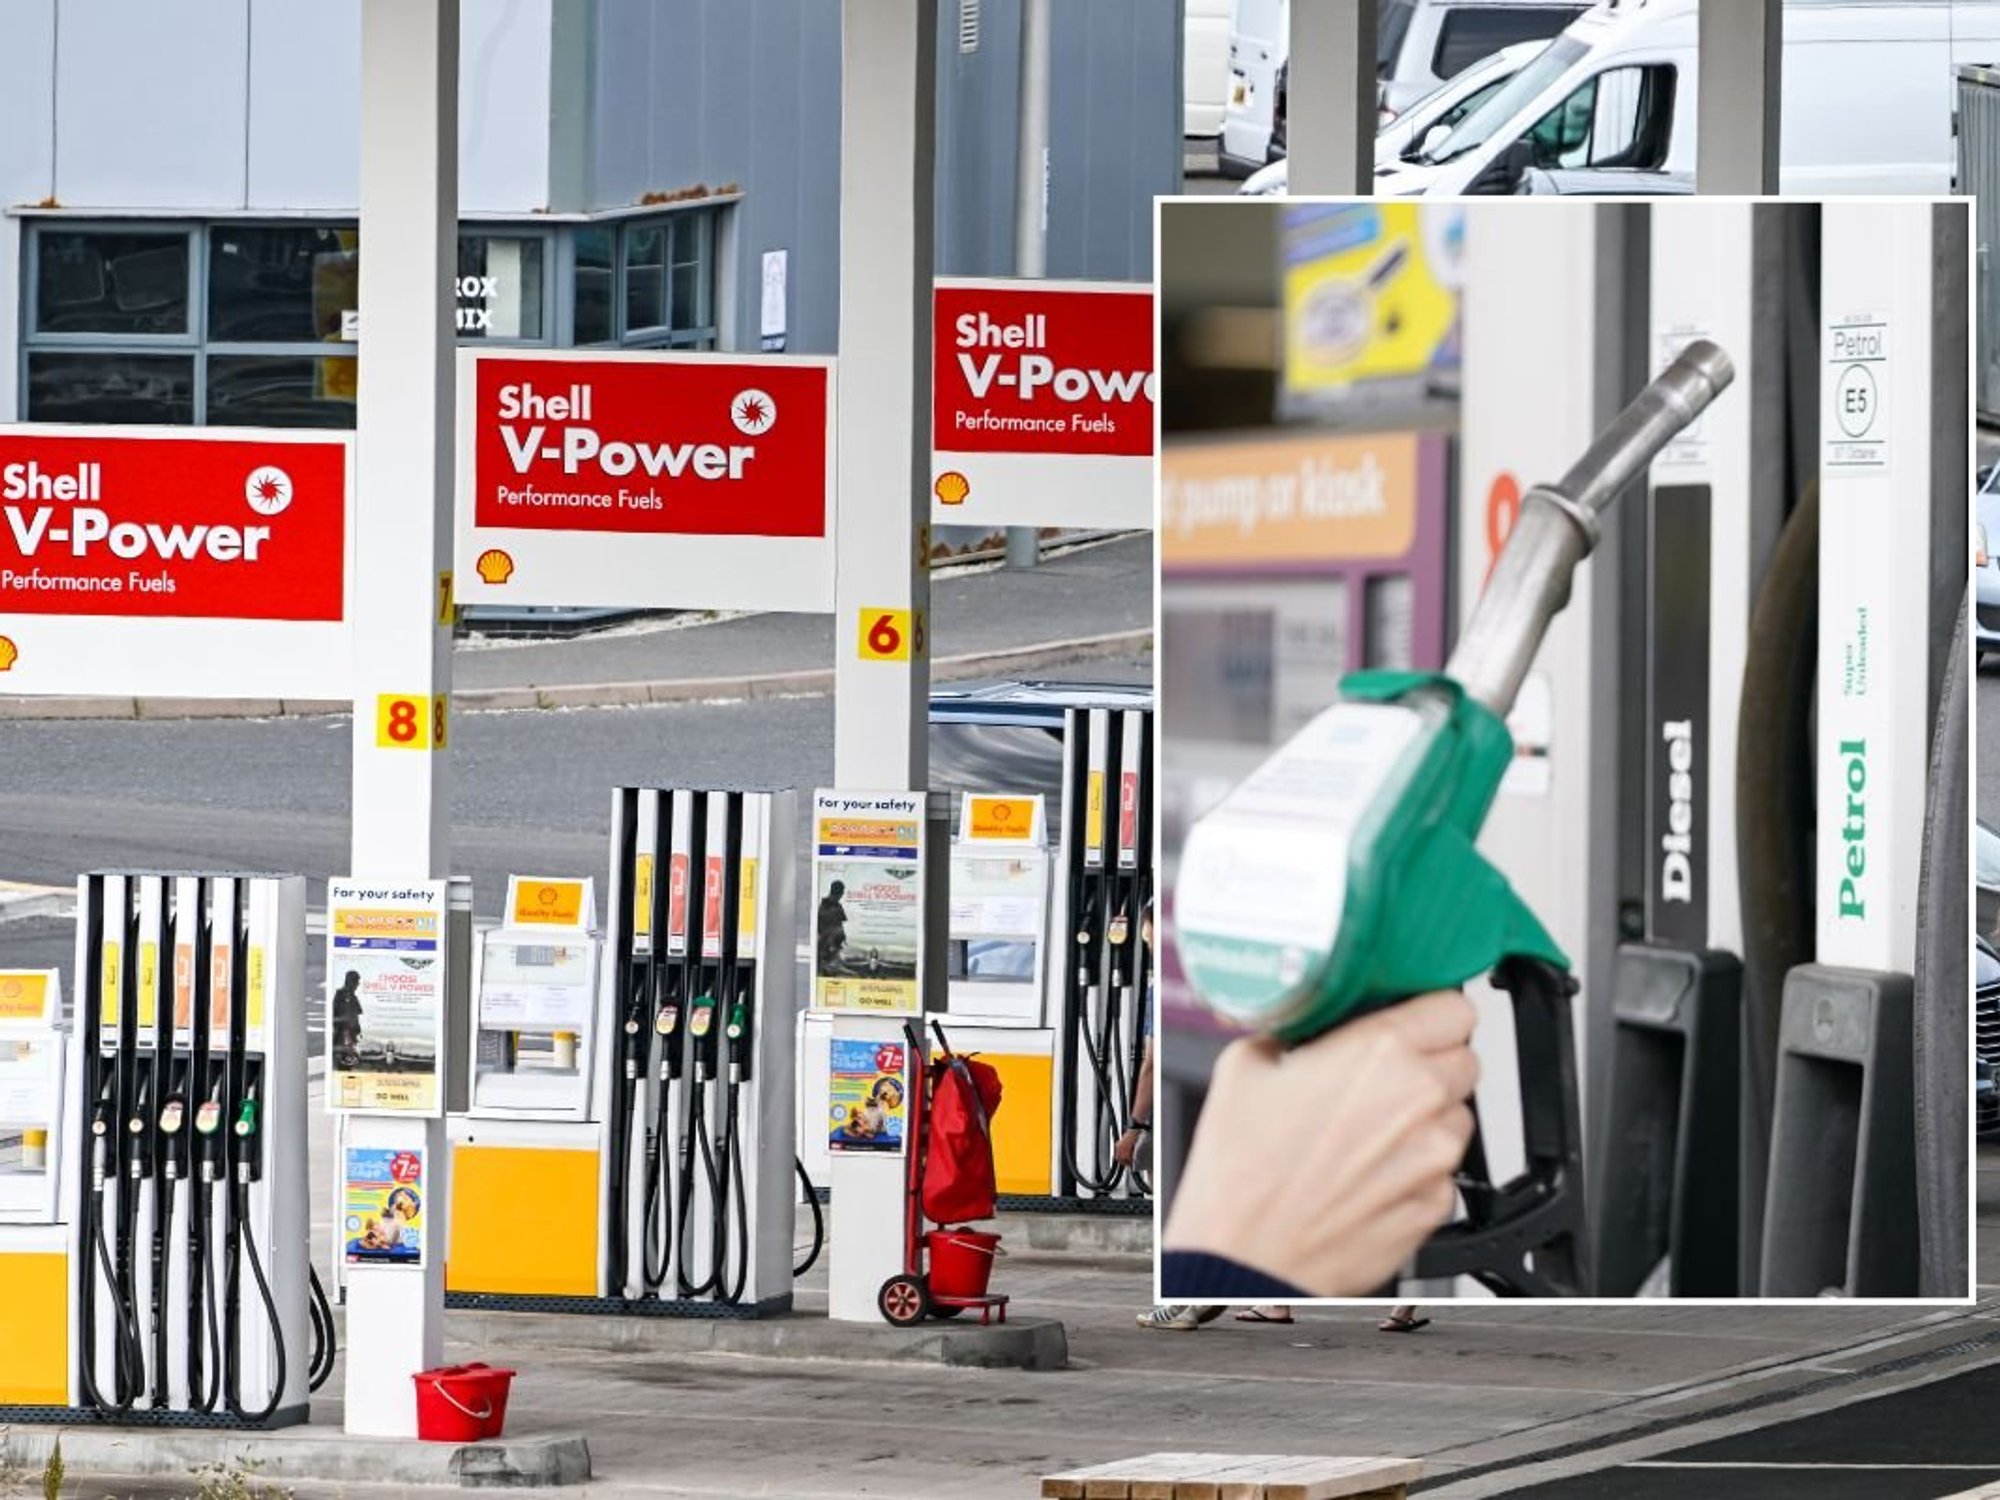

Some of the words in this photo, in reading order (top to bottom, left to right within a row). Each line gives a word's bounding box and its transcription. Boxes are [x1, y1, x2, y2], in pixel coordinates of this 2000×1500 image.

[956, 311, 1046, 348] Shell
[1834, 331, 1882, 356] Petrol
[498, 383, 592, 421] Shell
[1845, 389, 1867, 413] E5
[956, 409, 1066, 432] Performance
[1072, 412, 1116, 433] Fuels
[499, 425, 755, 480] V-Power
[3, 461, 100, 501] Shell
[497, 484, 613, 507] Performance
[618, 487, 664, 510] Fuels
[4, 506, 271, 560] V-Power
[2, 568, 123, 592] Performance
[129, 570, 177, 593] Fuels
[439, 577, 451, 620] 7
[868, 613, 901, 655] 6
[388, 700, 417, 742] 8
[434, 699, 444, 744] 8
[818, 797, 838, 808] For
[843, 800, 872, 811] your
[875, 799, 916, 813] safety
[1662, 718, 1694, 904] Diesel
[1839, 737, 1867, 920] Petrol
[333, 887, 356, 898] For
[358, 889, 389, 900] your
[392, 888, 435, 903] safety
